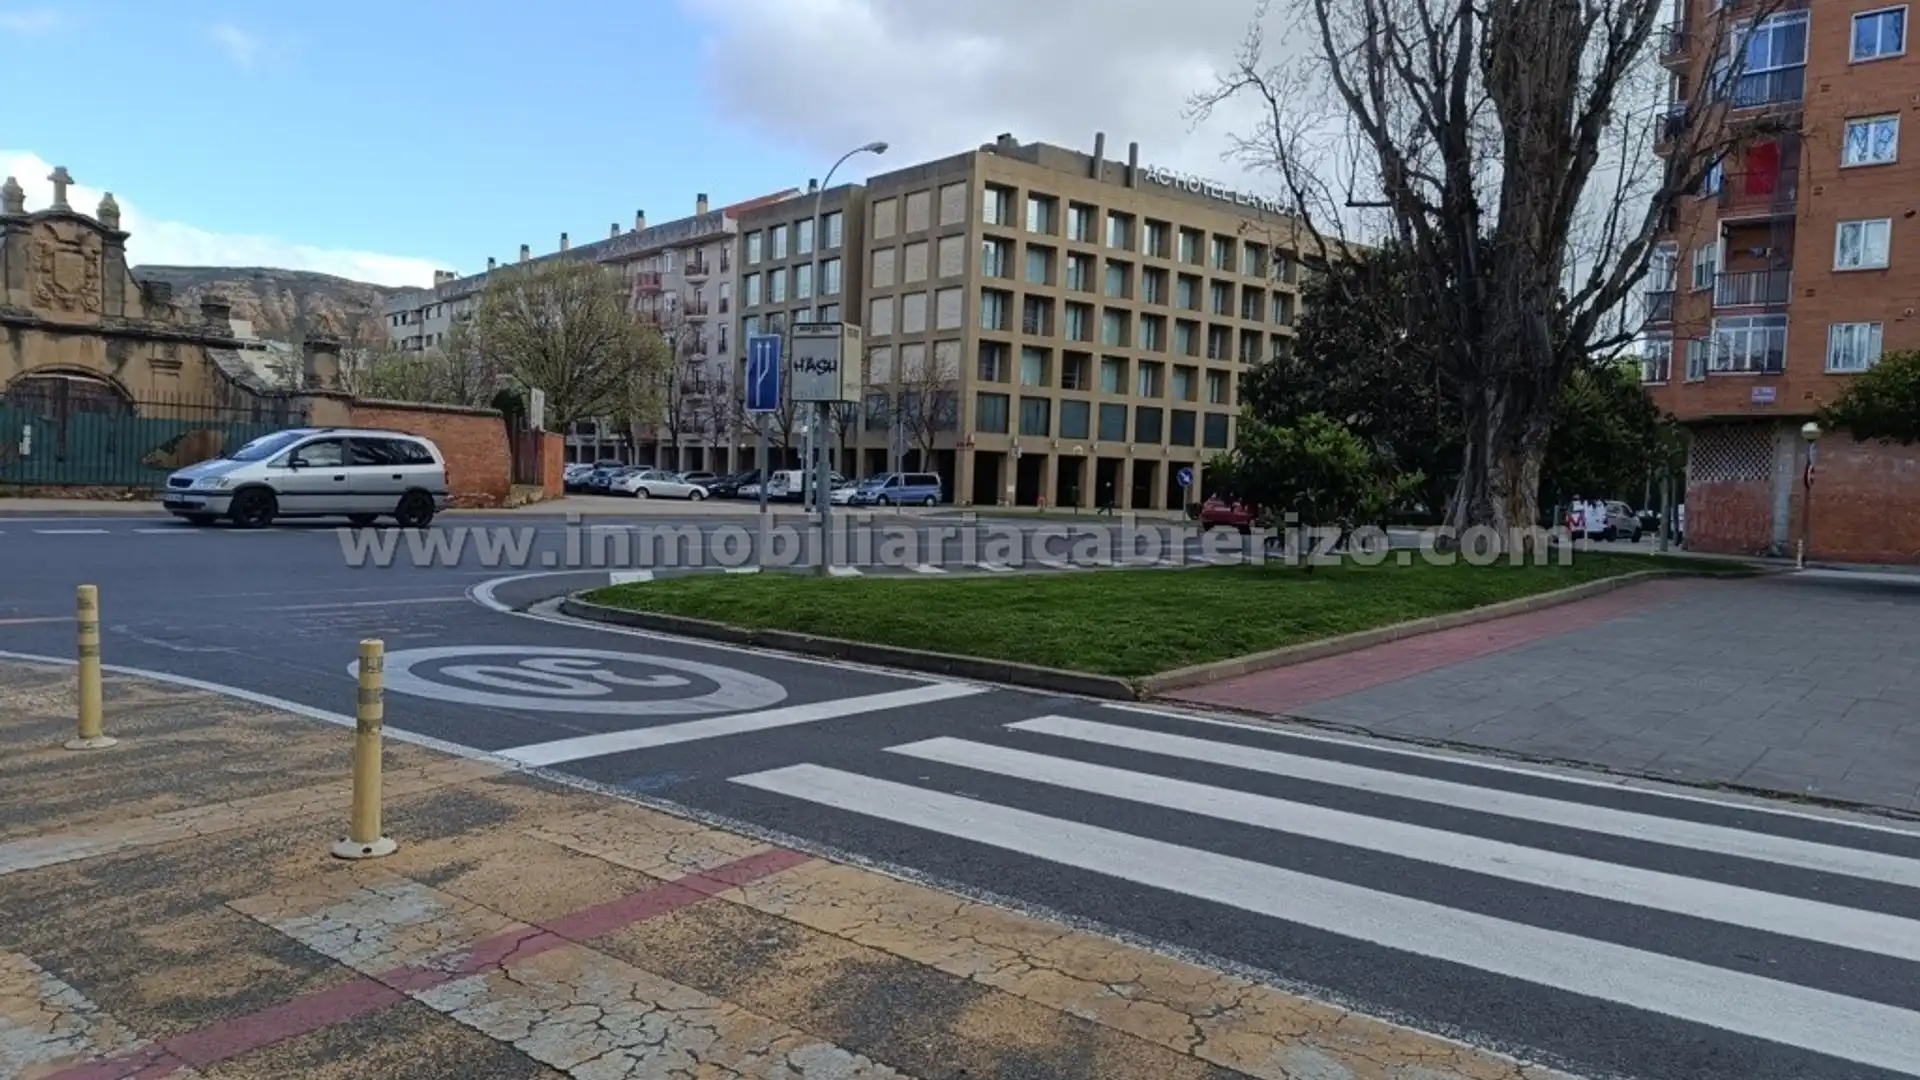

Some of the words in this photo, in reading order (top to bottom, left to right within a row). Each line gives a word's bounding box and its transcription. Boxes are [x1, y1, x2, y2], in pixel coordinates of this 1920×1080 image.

[1145, 163, 1172, 185] AC
[1175, 170, 1233, 202] HOTEL
[1235, 186, 1258, 208] LA
[1260, 195, 1305, 218] RIOA
[438, 657, 692, 697] 30
